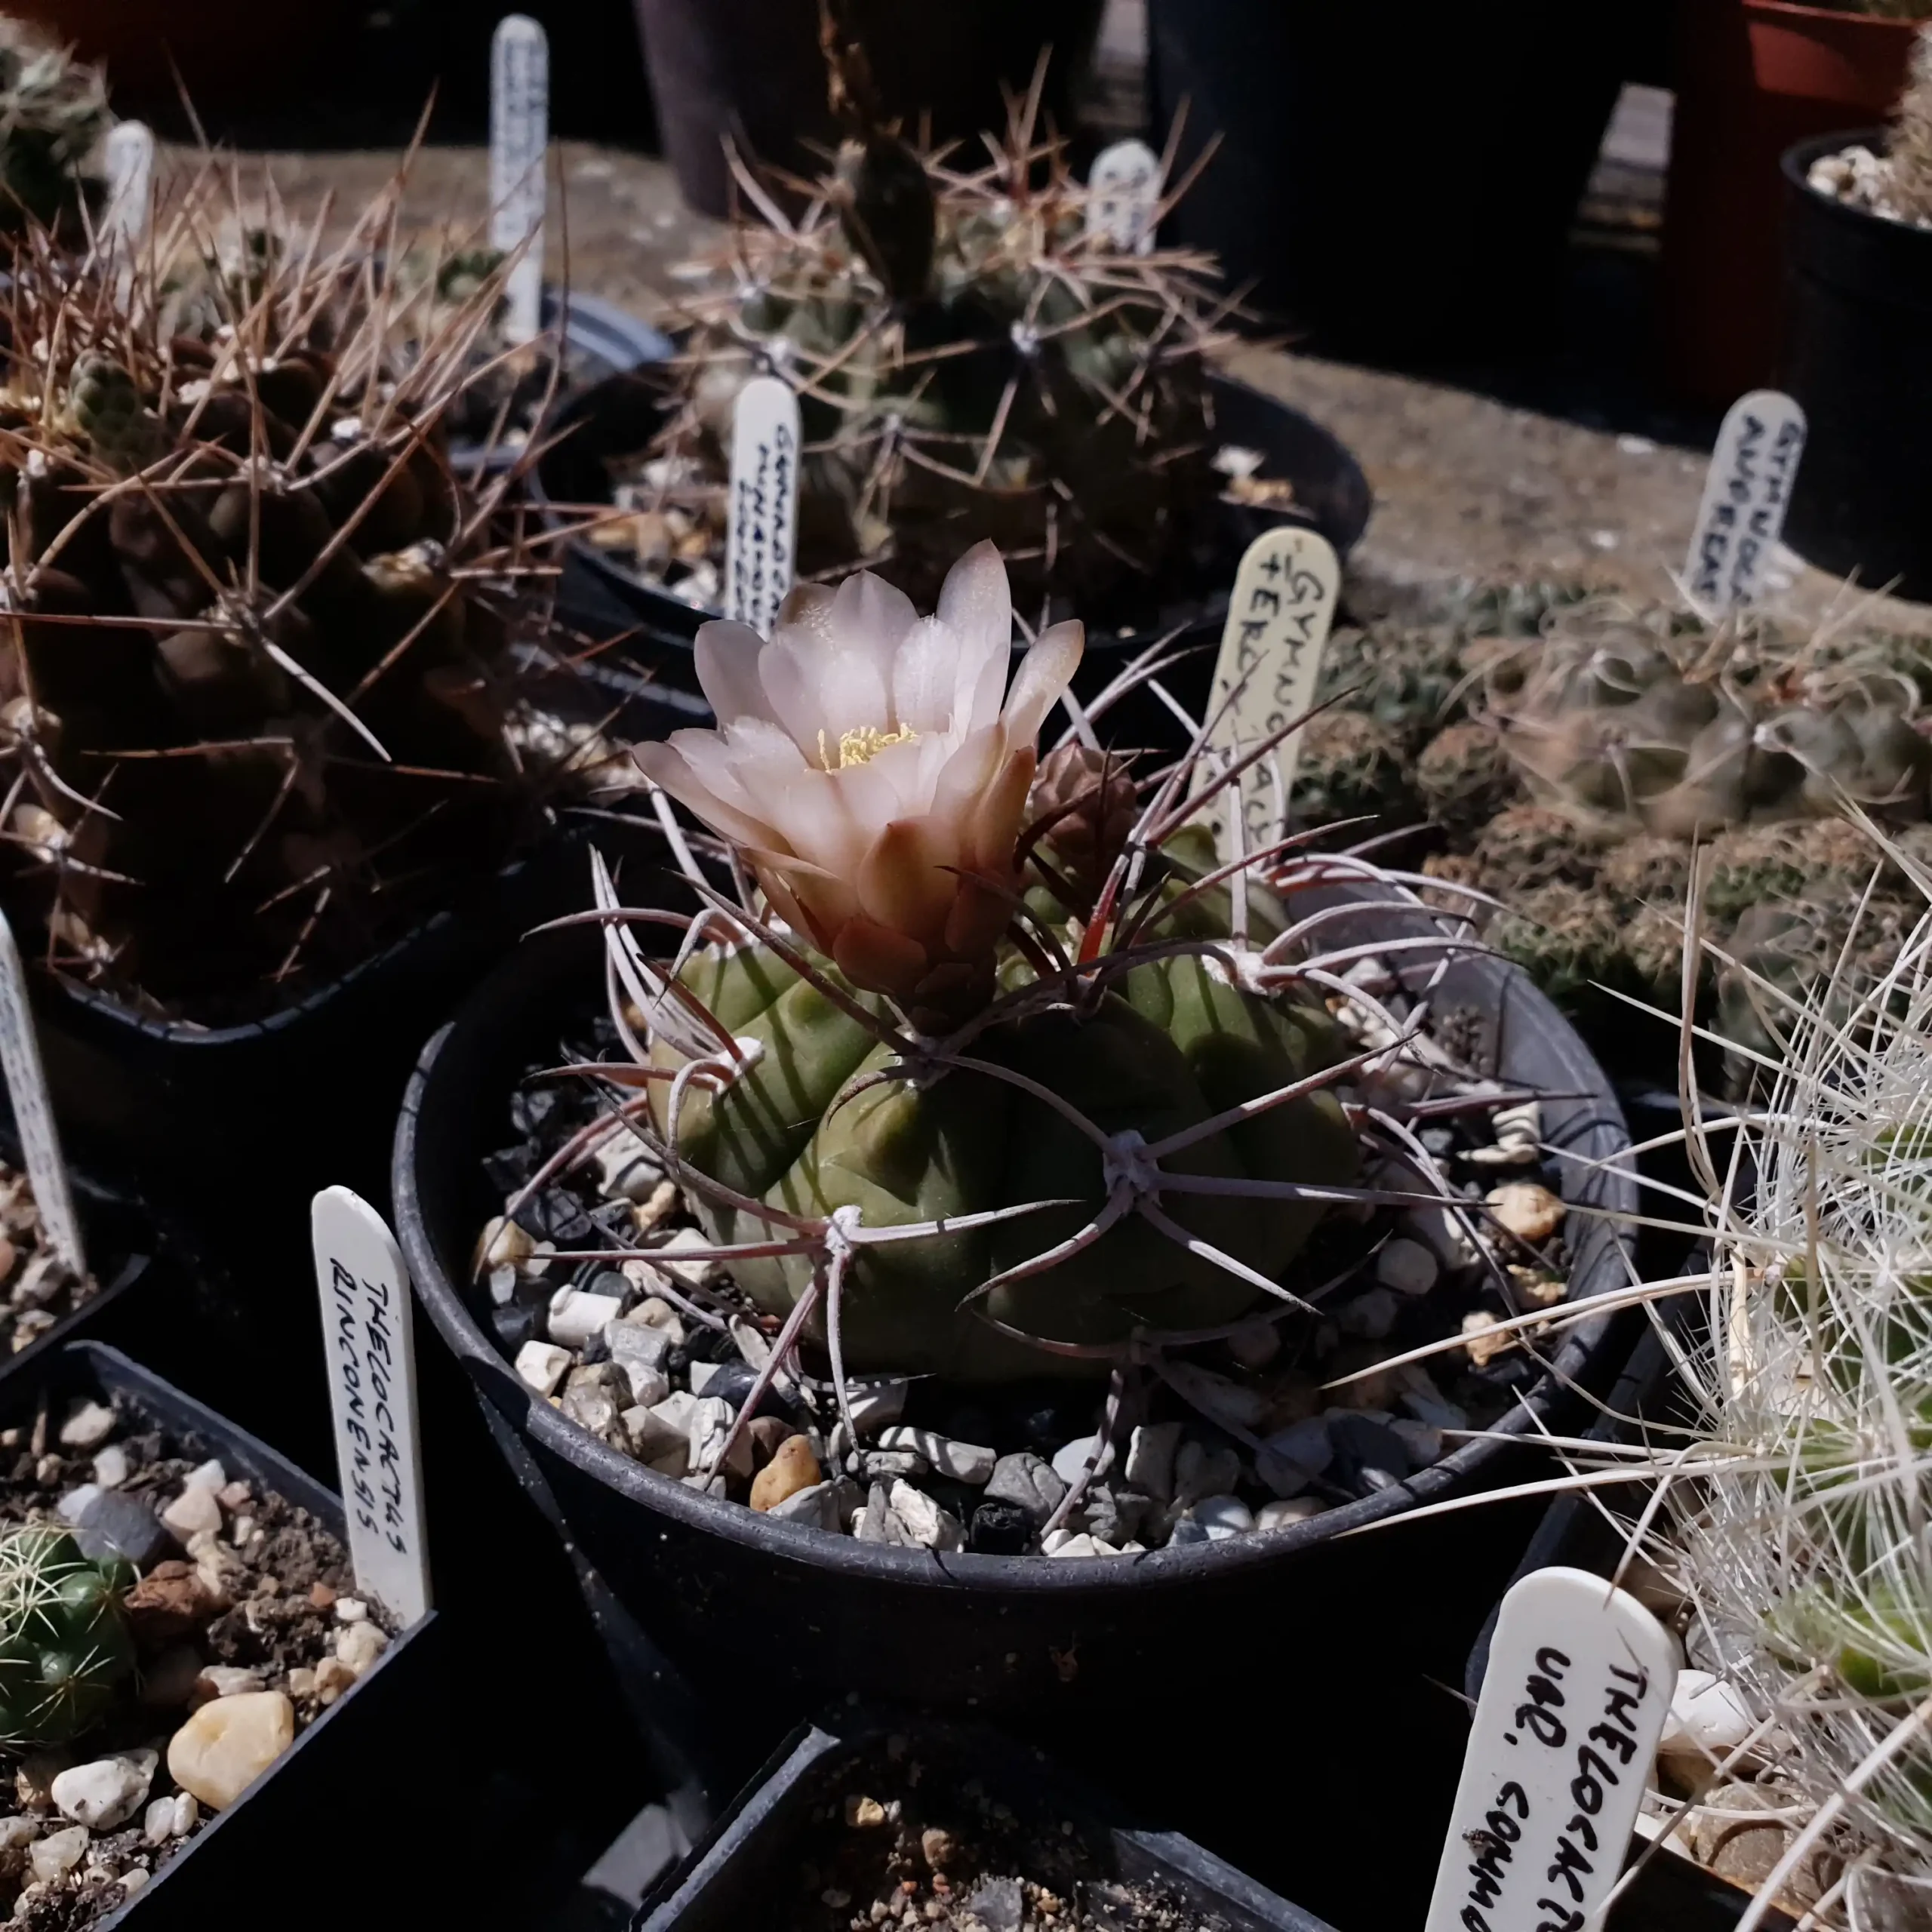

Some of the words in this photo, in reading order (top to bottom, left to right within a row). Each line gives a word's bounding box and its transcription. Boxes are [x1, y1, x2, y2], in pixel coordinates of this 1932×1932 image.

[330, 1257, 379, 1536] RINCONENSIS
[362, 1281, 408, 1556] THELOCACTUS
[1536, 1663, 1649, 1932] THELOCACT
